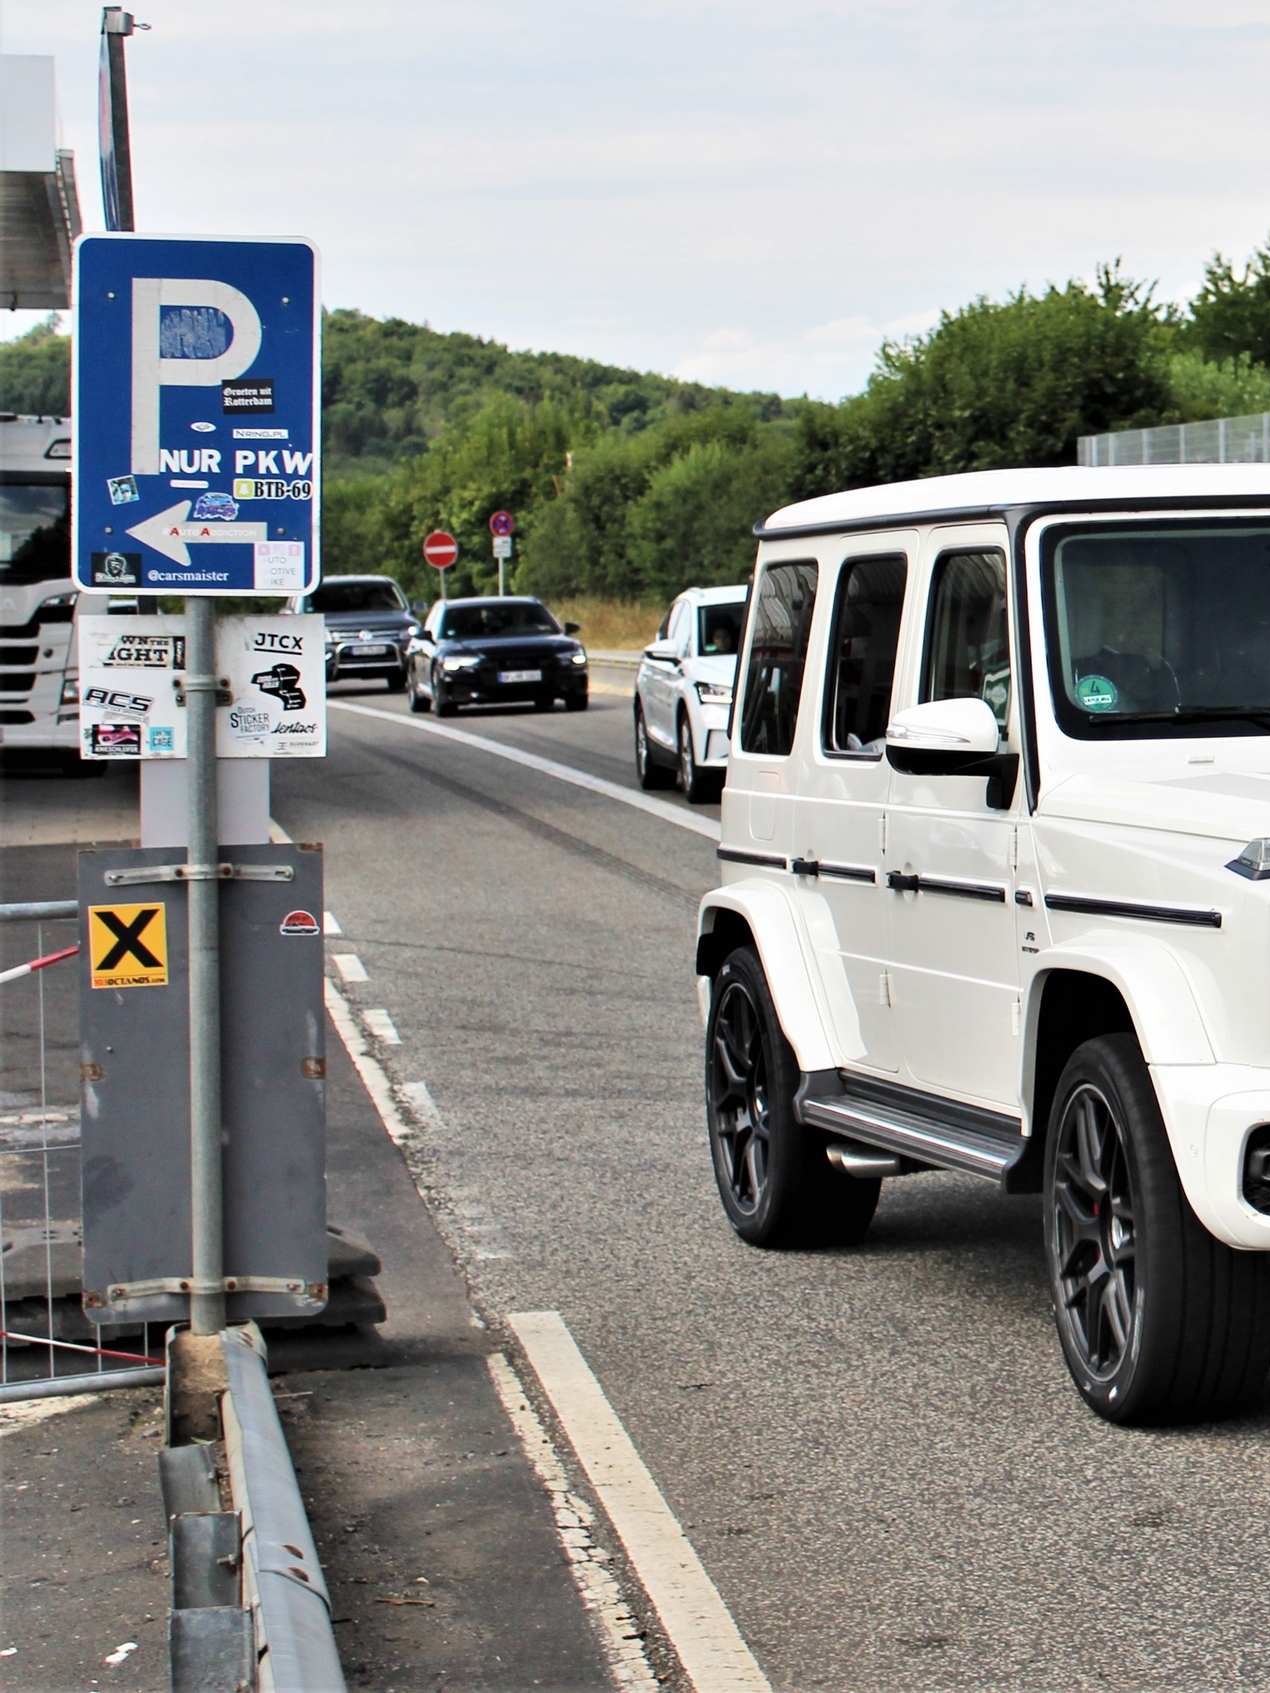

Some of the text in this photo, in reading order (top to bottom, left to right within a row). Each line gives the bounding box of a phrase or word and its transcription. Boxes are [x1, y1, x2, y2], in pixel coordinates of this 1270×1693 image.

[131, 277, 262, 475] P
[223, 386, 272, 396] Groeten uit
[223, 397, 273, 406] Rotterdam
[159, 448, 313, 476] NUR PKW
[254, 481, 312, 498] BTB-69
[147, 569, 229, 582] @carsmaister
[254, 632, 304, 650] JTCX
[1090, 680, 1101, 694] 4
[85, 688, 152, 712] ACS
[230, 712, 270, 729] STICKER
[240, 724, 270, 734] FACTORY
